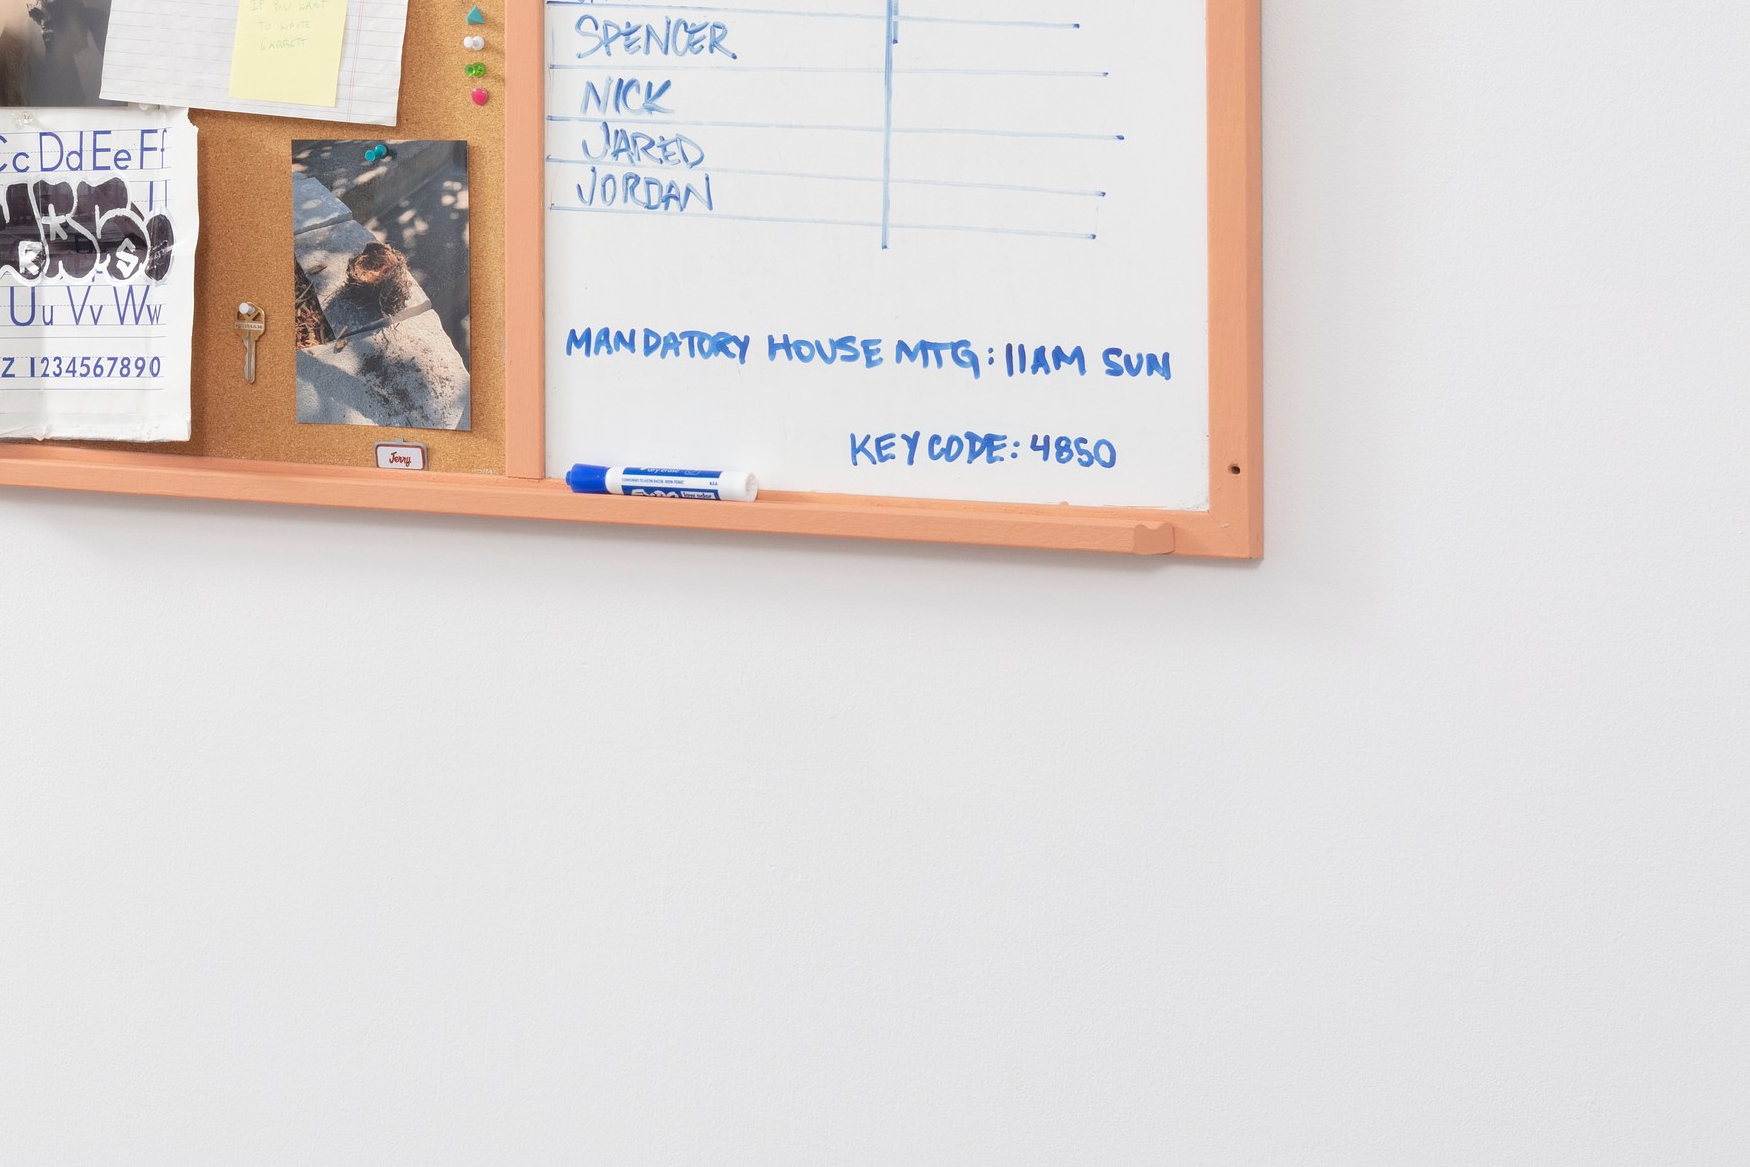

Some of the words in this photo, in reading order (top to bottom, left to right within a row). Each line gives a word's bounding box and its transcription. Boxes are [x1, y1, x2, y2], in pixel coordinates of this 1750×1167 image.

[257, 21, 272, 31] TO
[280, 20, 312, 32] WRITE
[298, 0, 330, 11] WANT
[575, 14, 738, 60] SPENCER
[580, 77, 675, 117] NICK
[39, 131, 83, 172] Dd
[93, 130, 132, 170] Ee
[581, 122, 705, 169] JARED
[576, 167, 714, 211] JORDAN
[10, 286, 54, 327] Uu
[67, 286, 103, 326] Vv
[113, 285, 162, 325] Ww
[30, 356, 161, 378] 1234567890
[566, 327, 750, 365] MANDATORY
[767, 334, 883, 369] HOUSE
[895, 340, 995, 380] MTG:
[1005, 343, 1086, 377] 11AM
[1104, 347, 1171, 380] SUN
[388, 451, 411, 467] Jerry
[1030, 434, 1117, 469] 4850
